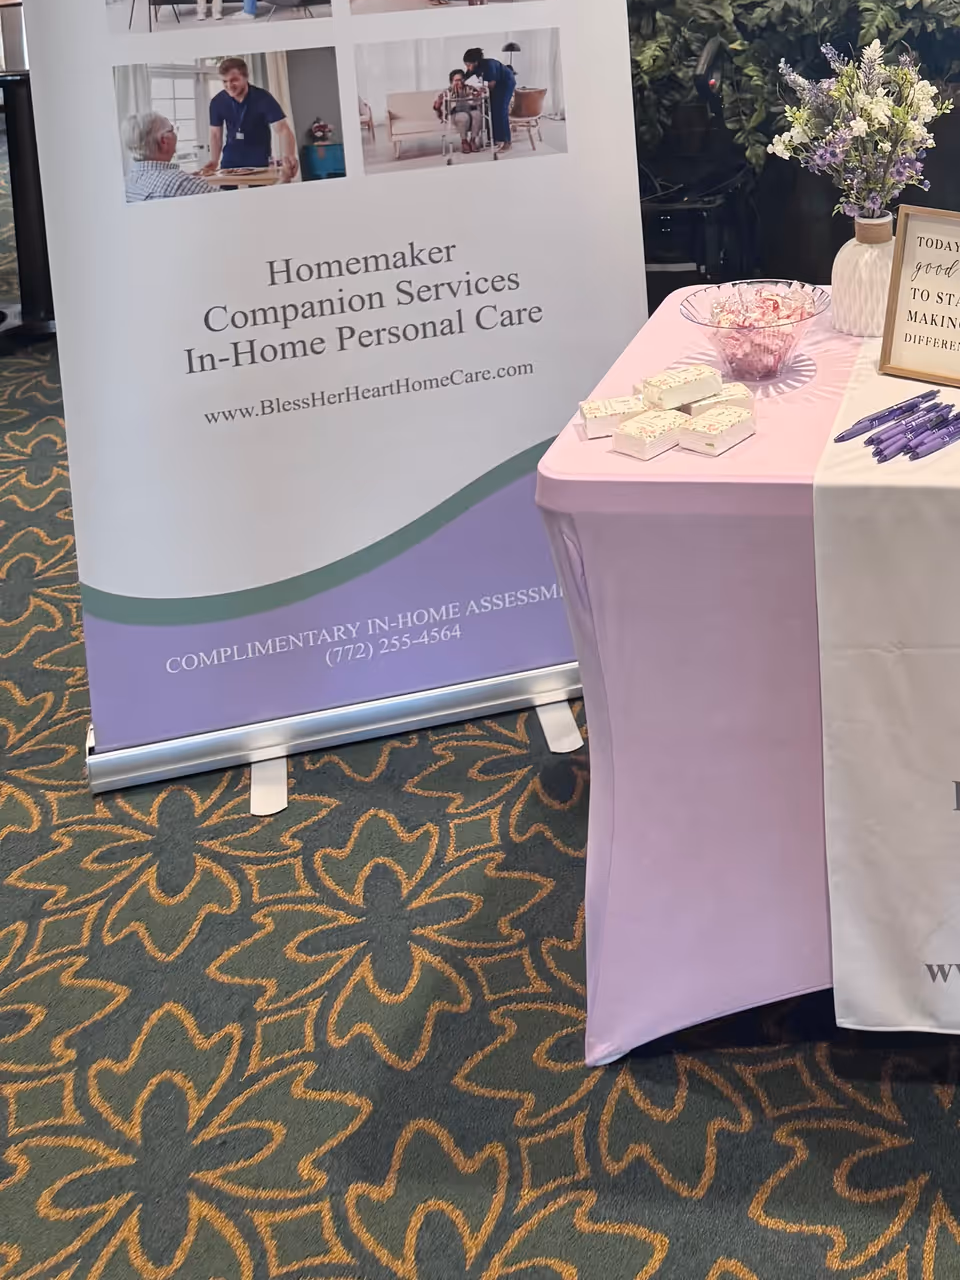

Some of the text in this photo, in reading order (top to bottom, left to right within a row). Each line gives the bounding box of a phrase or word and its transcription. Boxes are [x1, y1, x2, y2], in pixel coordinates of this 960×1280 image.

[267, 242, 456, 287] Homemaker
[911, 260, 960, 281] good
[202, 269, 520, 333] Companion Services
[911, 287, 930, 301] TO
[183, 302, 544, 375] In-Home Personal Care
[203, 361, 534, 424] www.BlessHerHeartHomeCare.com
[165, 582, 563, 674] COMPLIMENTARY IN-HOME ASSESSM
[325, 623, 463, 668] (772) 255-4564
